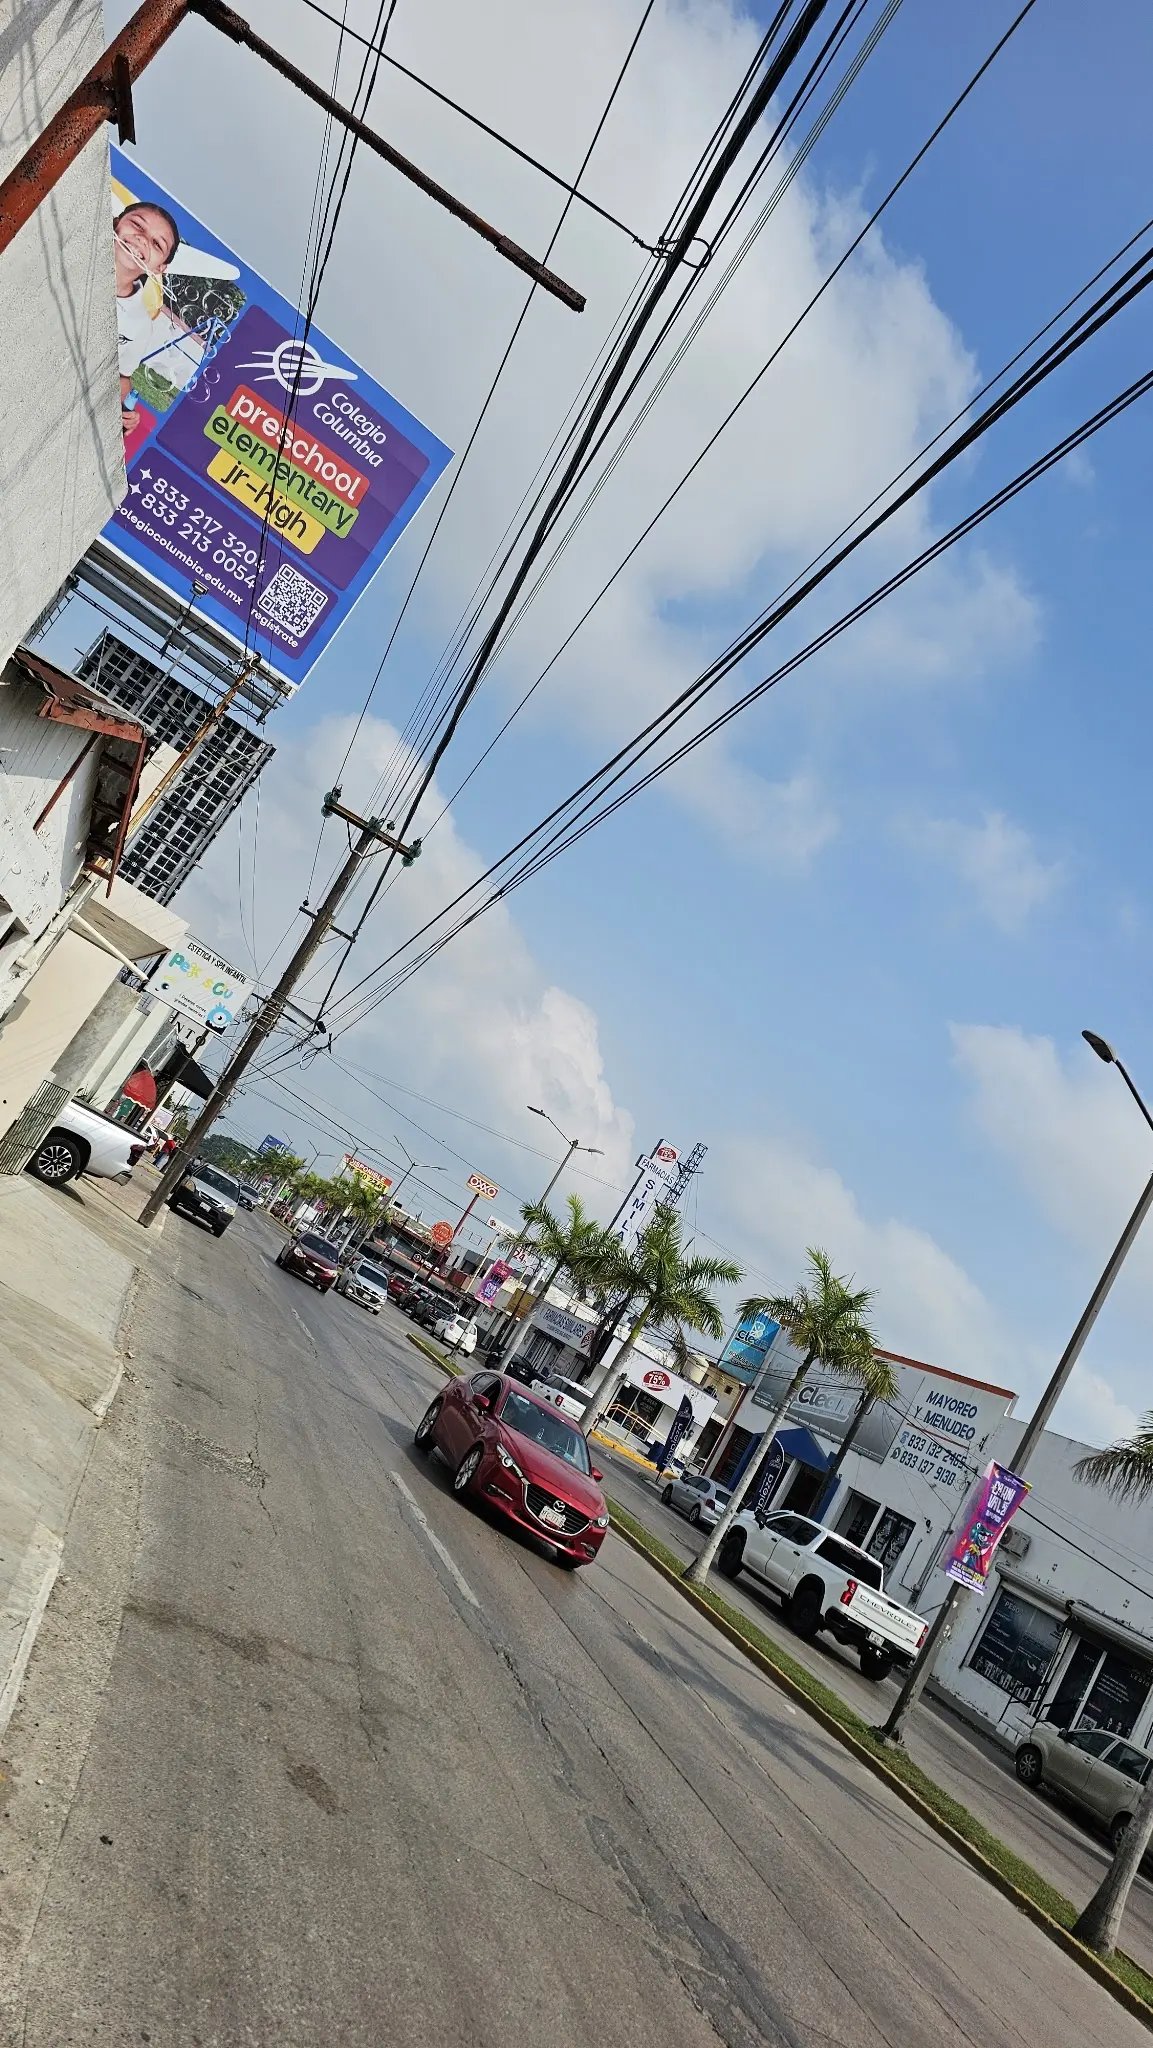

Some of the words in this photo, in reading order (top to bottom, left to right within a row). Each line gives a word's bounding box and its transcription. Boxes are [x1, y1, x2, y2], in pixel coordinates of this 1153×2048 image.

[313, 403, 383, 467] Columbia
[332, 393, 387, 445] Colegio
[231, 395, 361, 500] preschool
[212, 417, 354, 530] elementary
[153, 478, 190, 511] 833
[190, 508, 223, 534] 217
[221, 461, 307, 539] jr-high
[141, 494, 178, 526] 833
[178, 523, 212, 553] 213
[212, 550, 256, 589] 0054
[187, 942, 212, 962] ESTETICA
[215, 960, 225, 971] SPA
[224, 965, 247, 985] INFANTIL
[470, 1177, 497, 1197] OXXO
[641, 1158, 674, 1186] FARMACIAS
[648, 1373, 666, 1386] 75%
[799, 1386, 845, 1414] Clean
[926, 1390, 978, 1419] MAYOREO
[914, 1405, 923, 1419] Y
[923, 1410, 976, 1441] MENUDEO
[907, 1434, 927, 1452] 833
[926, 1442, 942, 1459] 132
[899, 1450, 919, 1469] 833
[917, 1459, 935, 1475] 137
[933, 1466, 957, 1486] 9130
[860, 1594, 917, 1632] CHEVROLET
